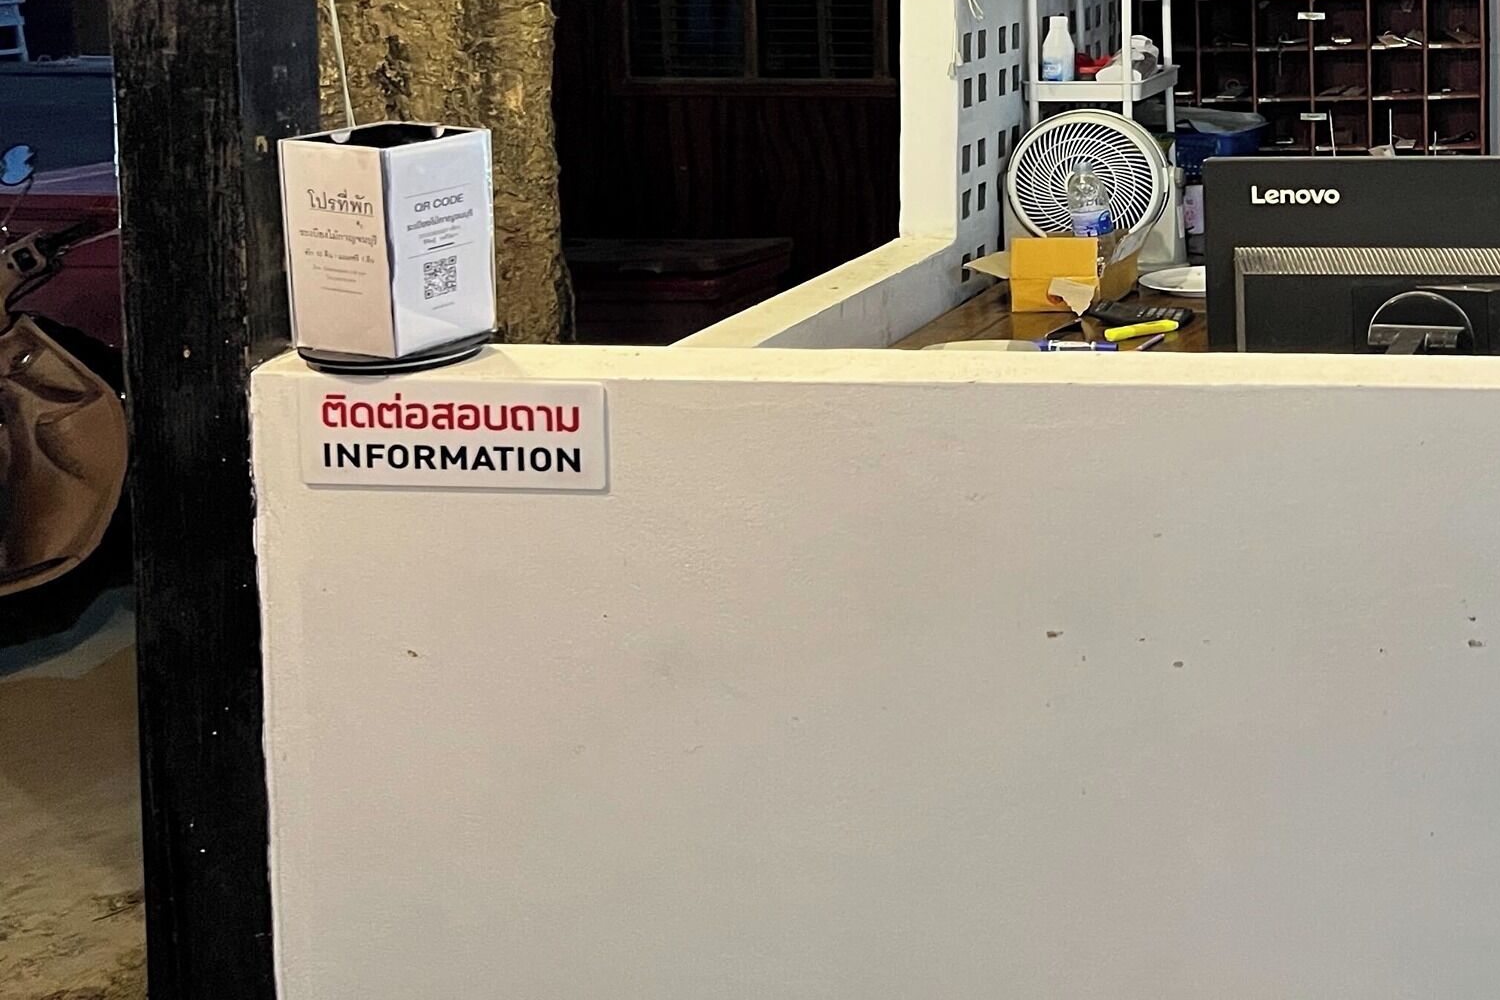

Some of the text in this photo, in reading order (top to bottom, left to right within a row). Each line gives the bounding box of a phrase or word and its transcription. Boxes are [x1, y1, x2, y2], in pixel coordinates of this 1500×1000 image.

[414, 193, 464, 213] QR CODE
[1251, 185, 1341, 205] Lenovo
[322, 393, 580, 432] ติดต่อสอบถาม
[323, 443, 581, 473] INFORMATION
